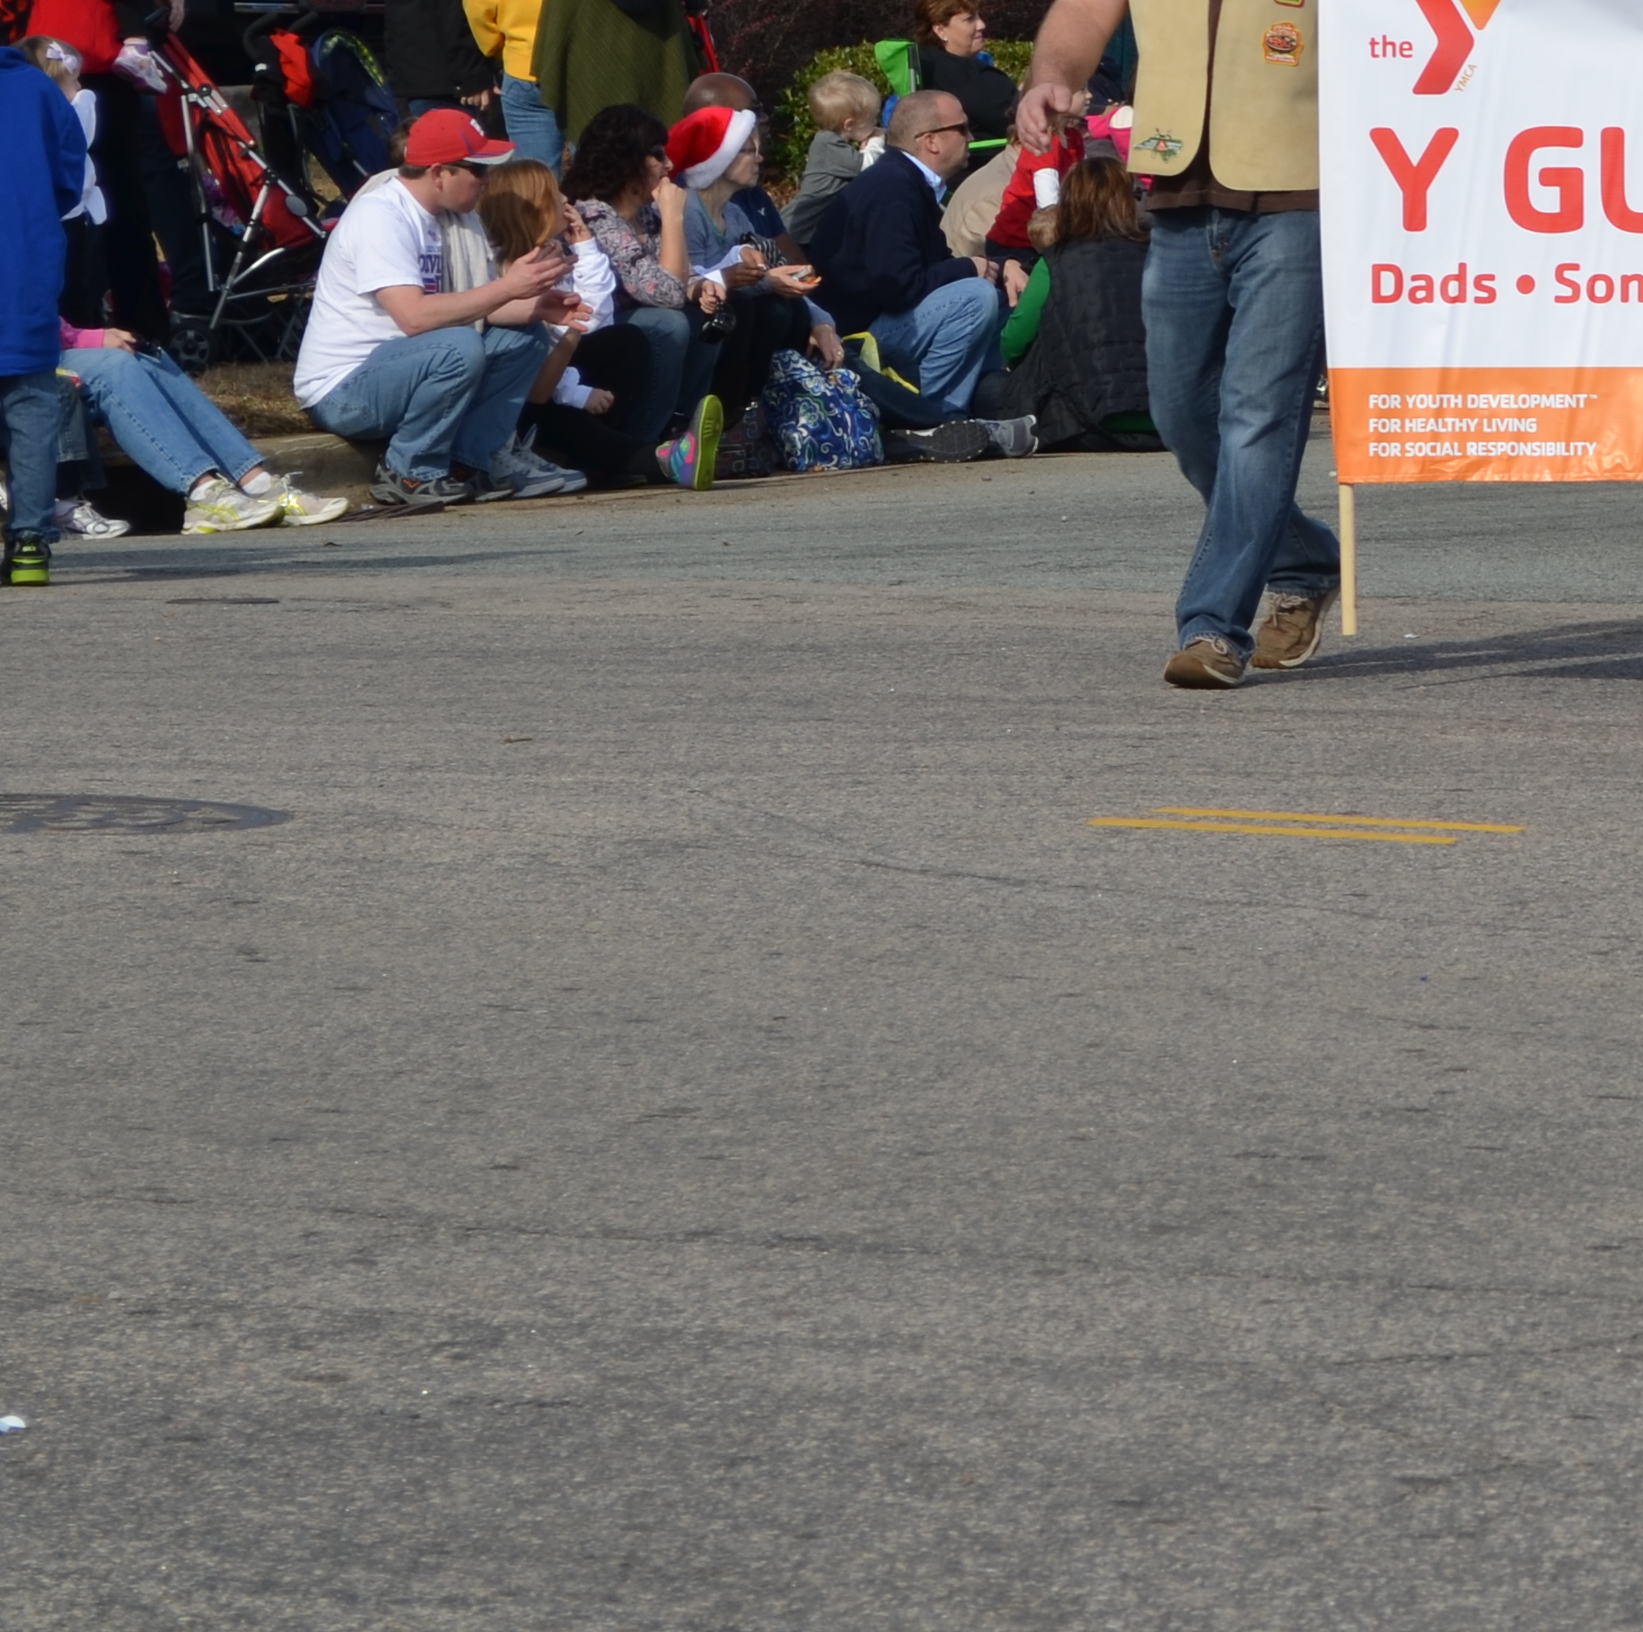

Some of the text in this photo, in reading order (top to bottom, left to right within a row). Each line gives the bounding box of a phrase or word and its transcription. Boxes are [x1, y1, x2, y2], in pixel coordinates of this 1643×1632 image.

[1369, 34, 1413, 58] the
[1454, 63, 1477, 92] YMCA
[1370, 126, 1459, 233] Y
[1371, 262, 1497, 305] Dads
[1368, 394, 1402, 410] FOR
[1405, 394, 1463, 410] YOUTH
[1368, 418, 1538, 433] FOR HEALTHY LIVING
[1368, 441, 1598, 458] FOR SOCIAL RESPONSIBILITY
